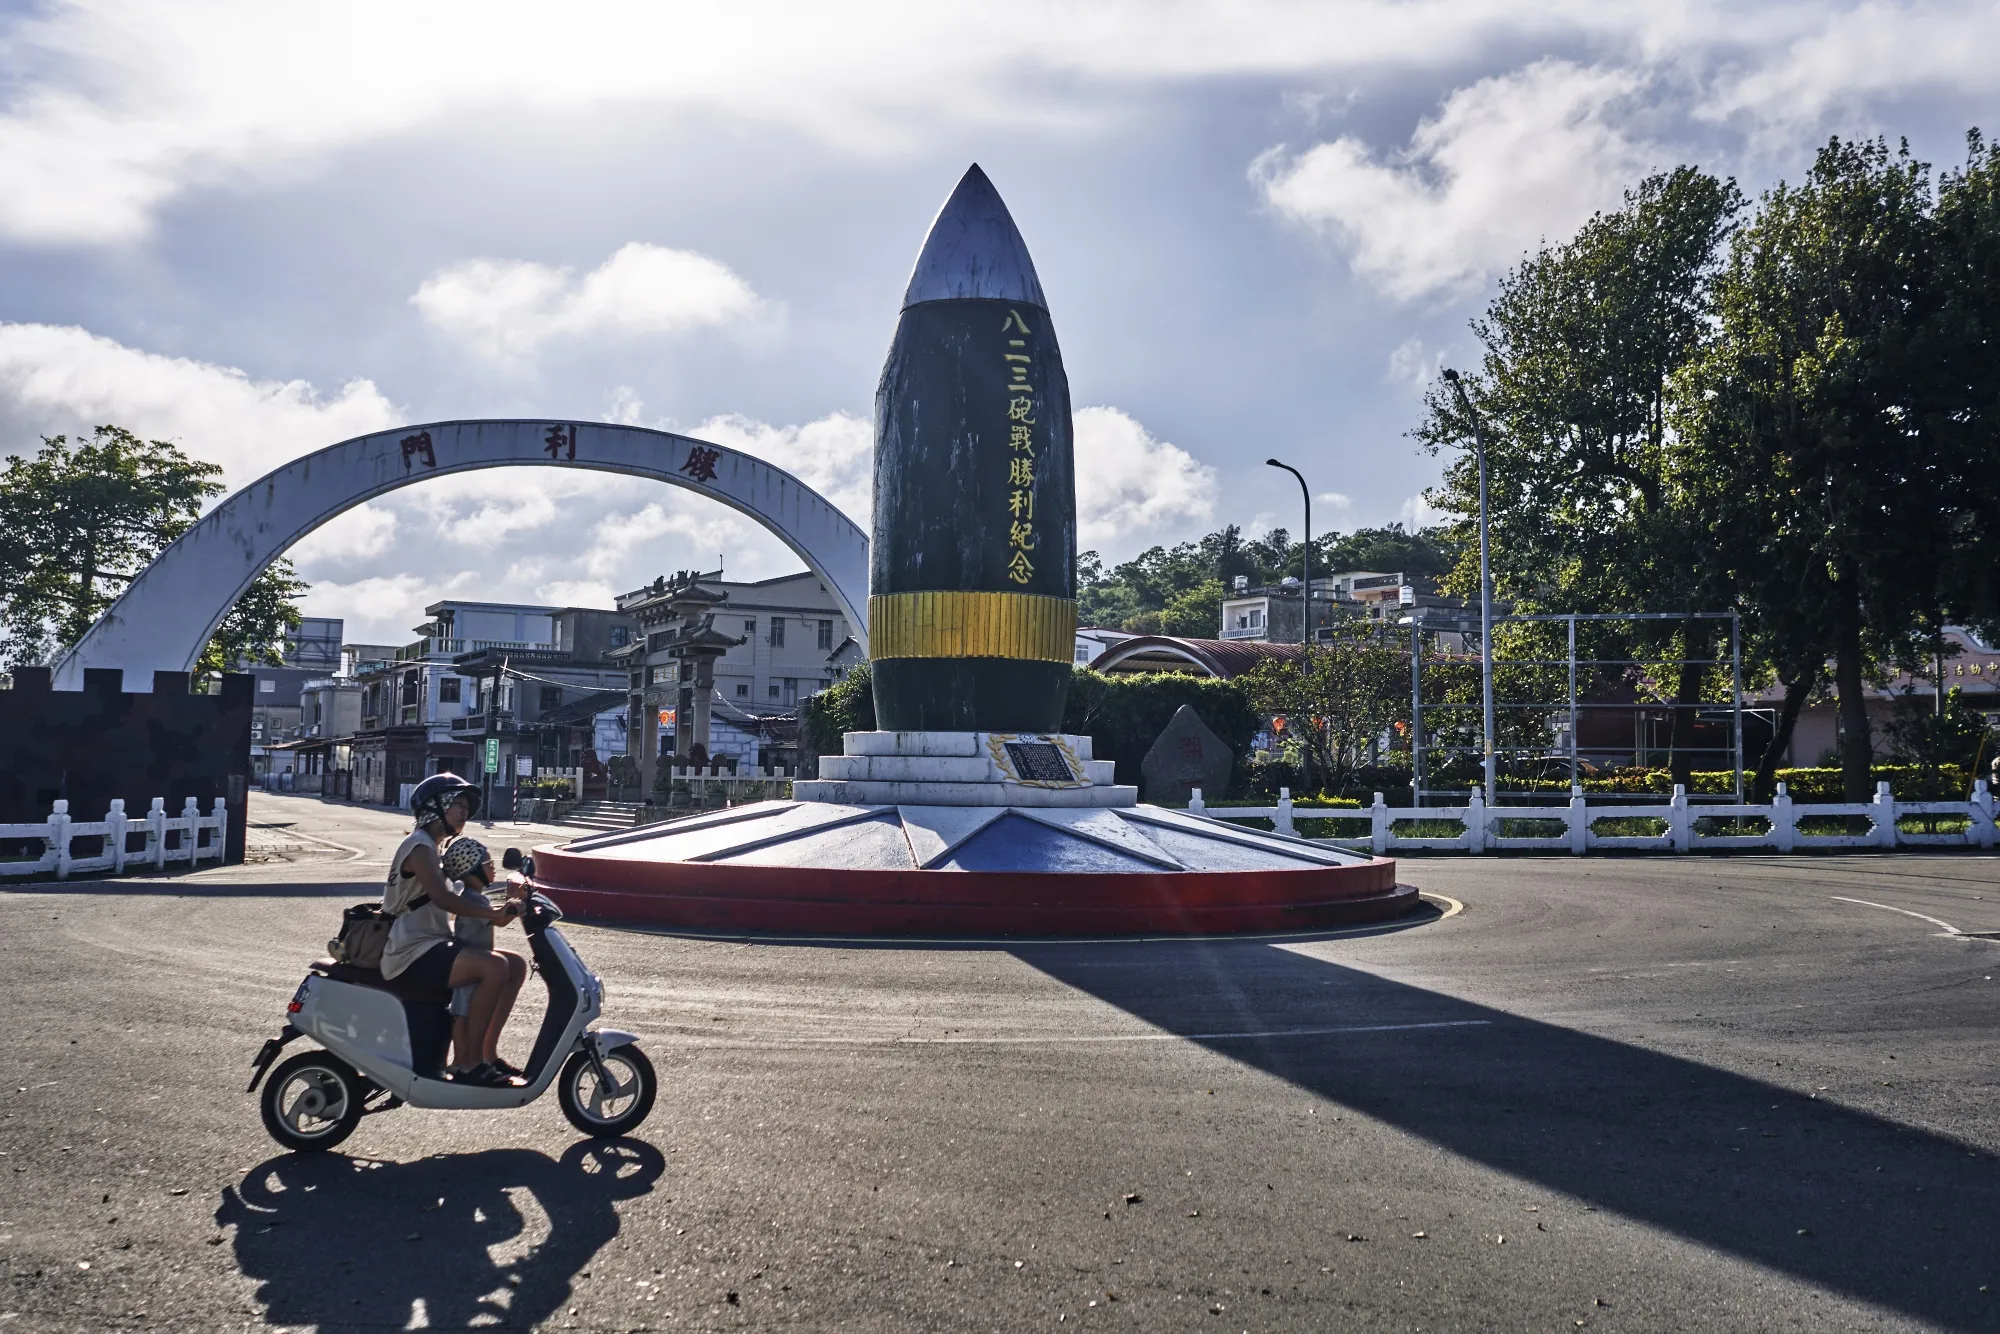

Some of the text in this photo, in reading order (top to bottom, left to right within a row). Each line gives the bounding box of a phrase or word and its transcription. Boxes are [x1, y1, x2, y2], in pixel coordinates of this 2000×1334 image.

[1001, 309, 1036, 585] 八二三砲戰勝利紀念
